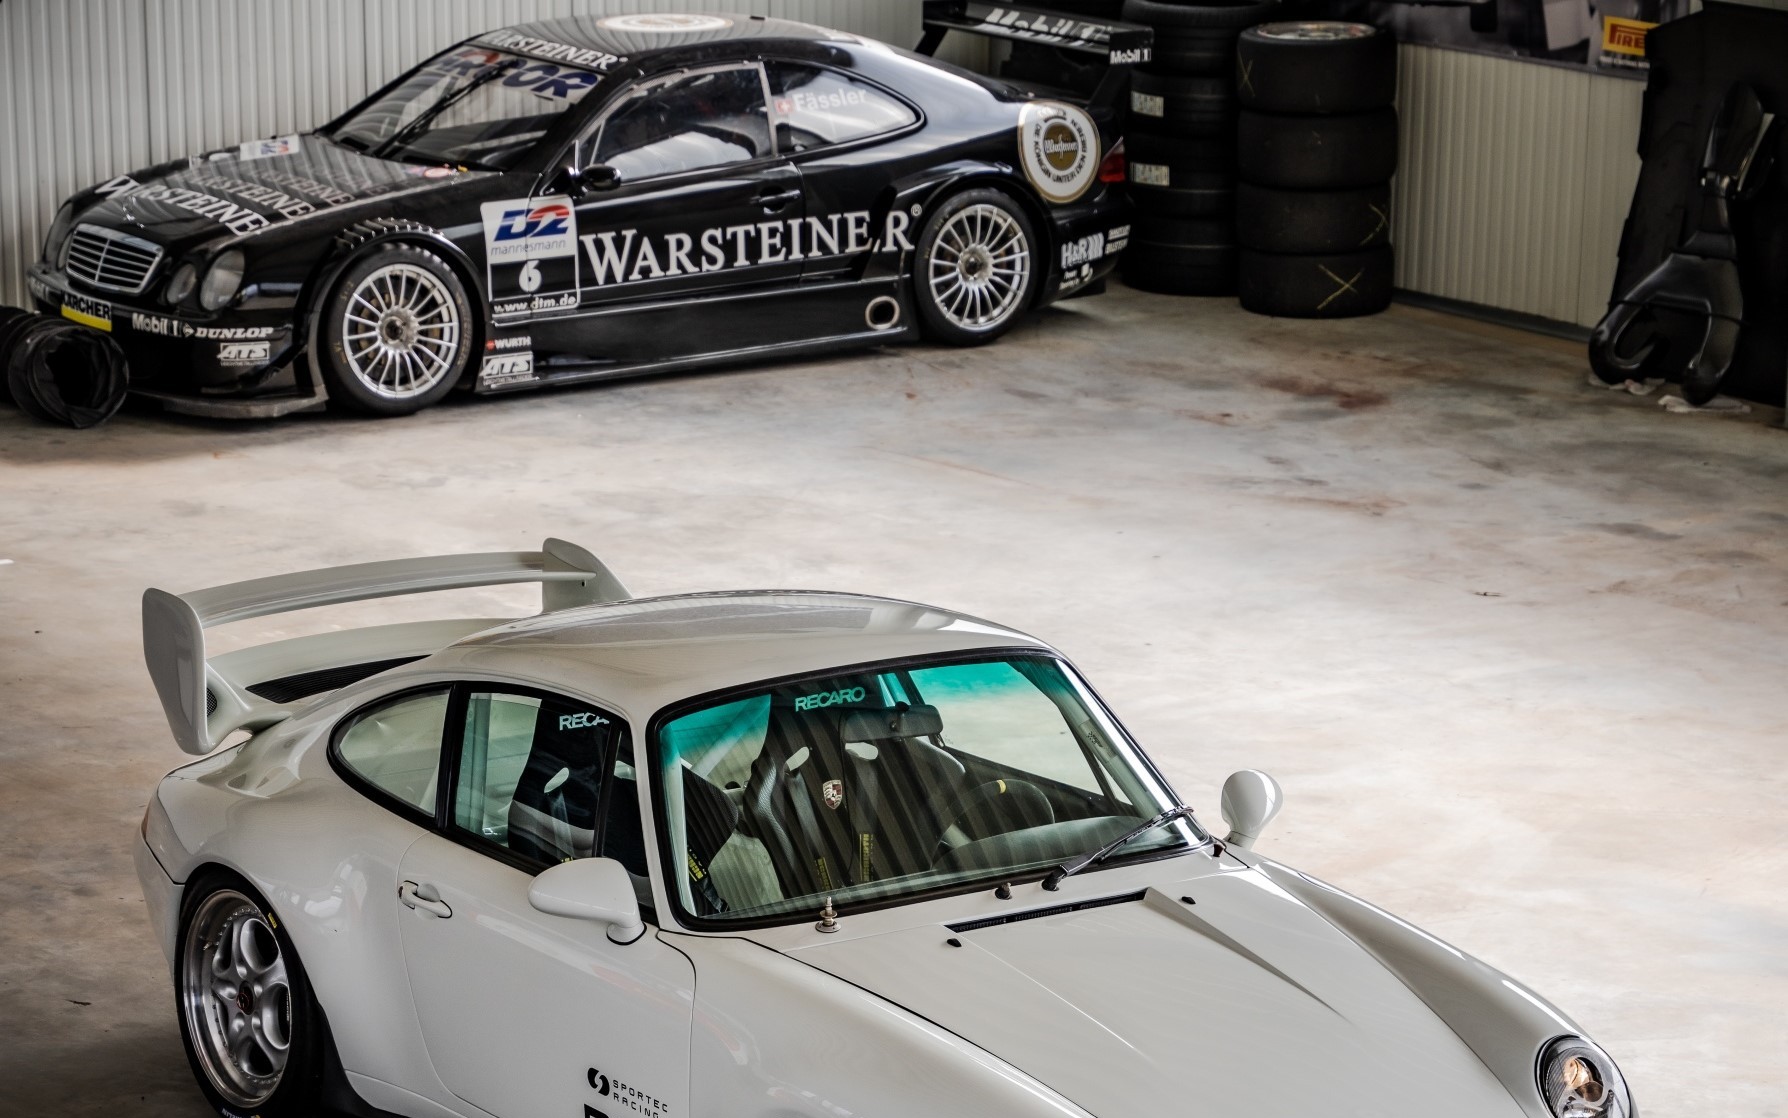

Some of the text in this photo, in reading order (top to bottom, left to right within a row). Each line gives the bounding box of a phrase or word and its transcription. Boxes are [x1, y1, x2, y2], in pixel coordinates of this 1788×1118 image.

[1608, 22, 1648, 49] PIRE
[791, 87, 867, 112] Fässler
[493, 204, 571, 242] D2
[490, 240, 567, 256] mannesmann
[579, 209, 916, 286] WARSTEINER
[518, 260, 542, 292] 6
[132, 312, 168, 335] Mobil
[195, 327, 274, 339] DUNLOP
[216, 341, 270, 360] ATS
[479, 353, 533, 377] ATS
[794, 686, 866, 712] RECARO
[559, 712, 610, 731] RECA
[612, 1079, 668, 1113] SPORTEC
